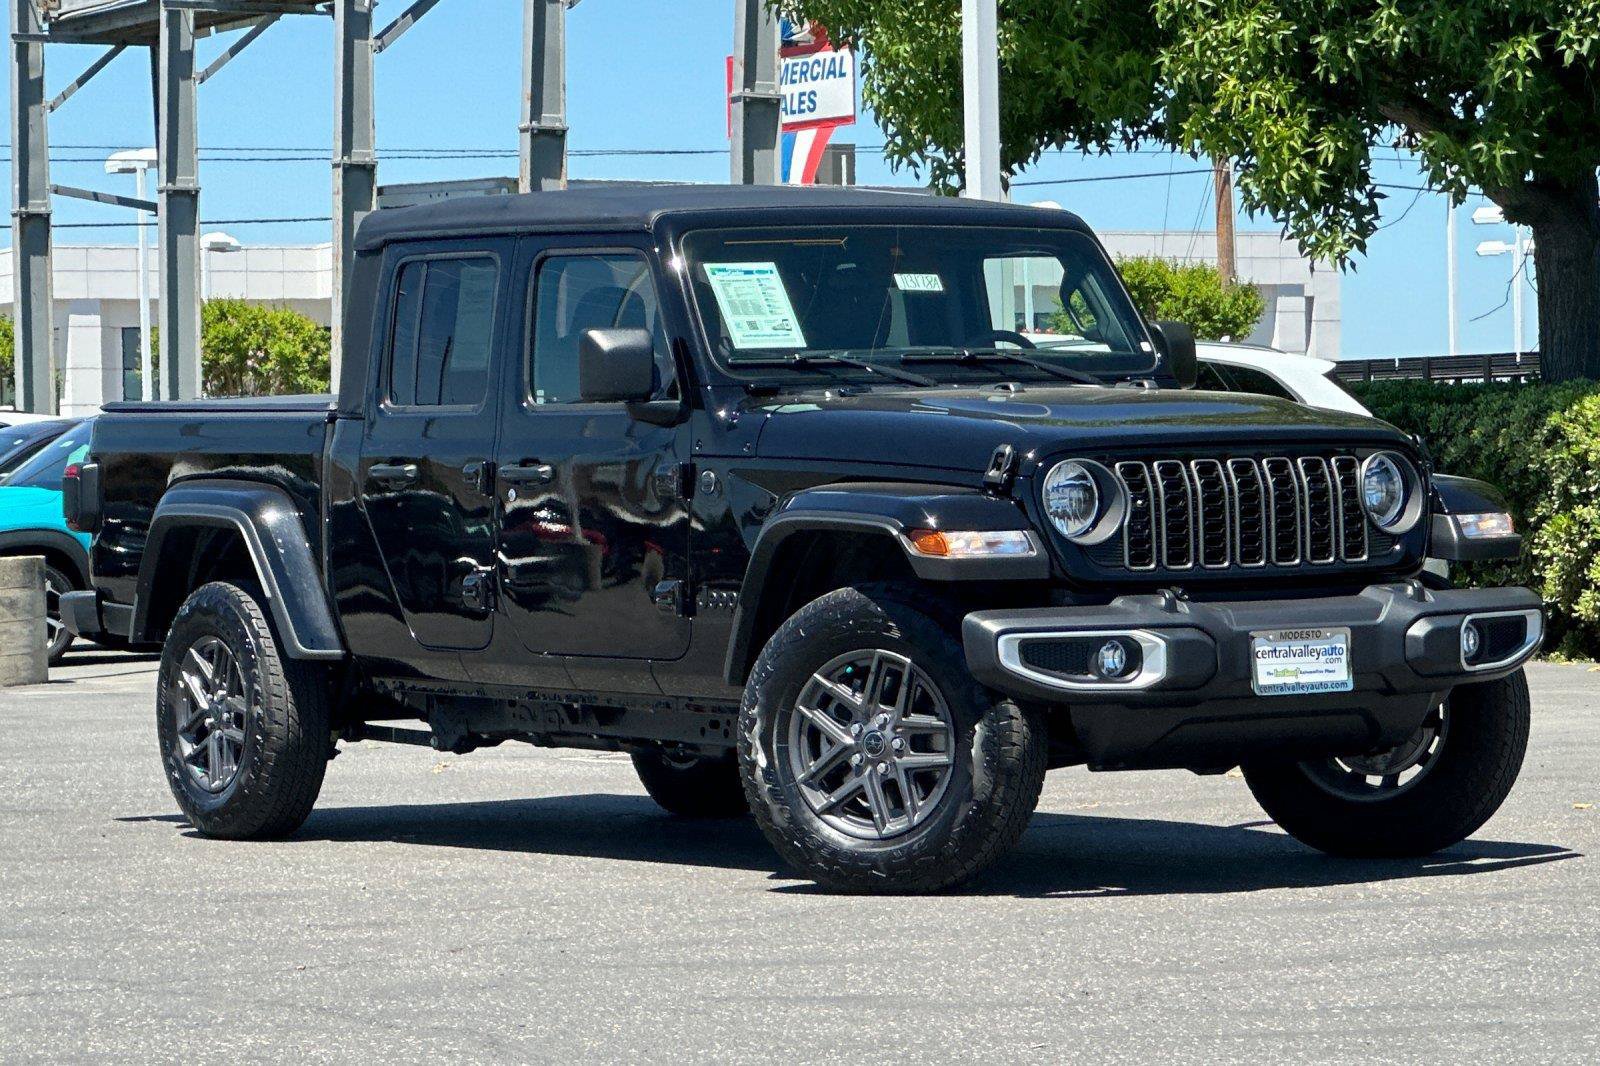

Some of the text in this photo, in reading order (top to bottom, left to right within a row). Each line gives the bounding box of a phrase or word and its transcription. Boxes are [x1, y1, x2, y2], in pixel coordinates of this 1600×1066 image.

[1279, 630, 1321, 639] MODESTO
[1256, 645, 1344, 660] centralvalleyauto
[1259, 681, 1348, 693] centralvalleyauto.com
